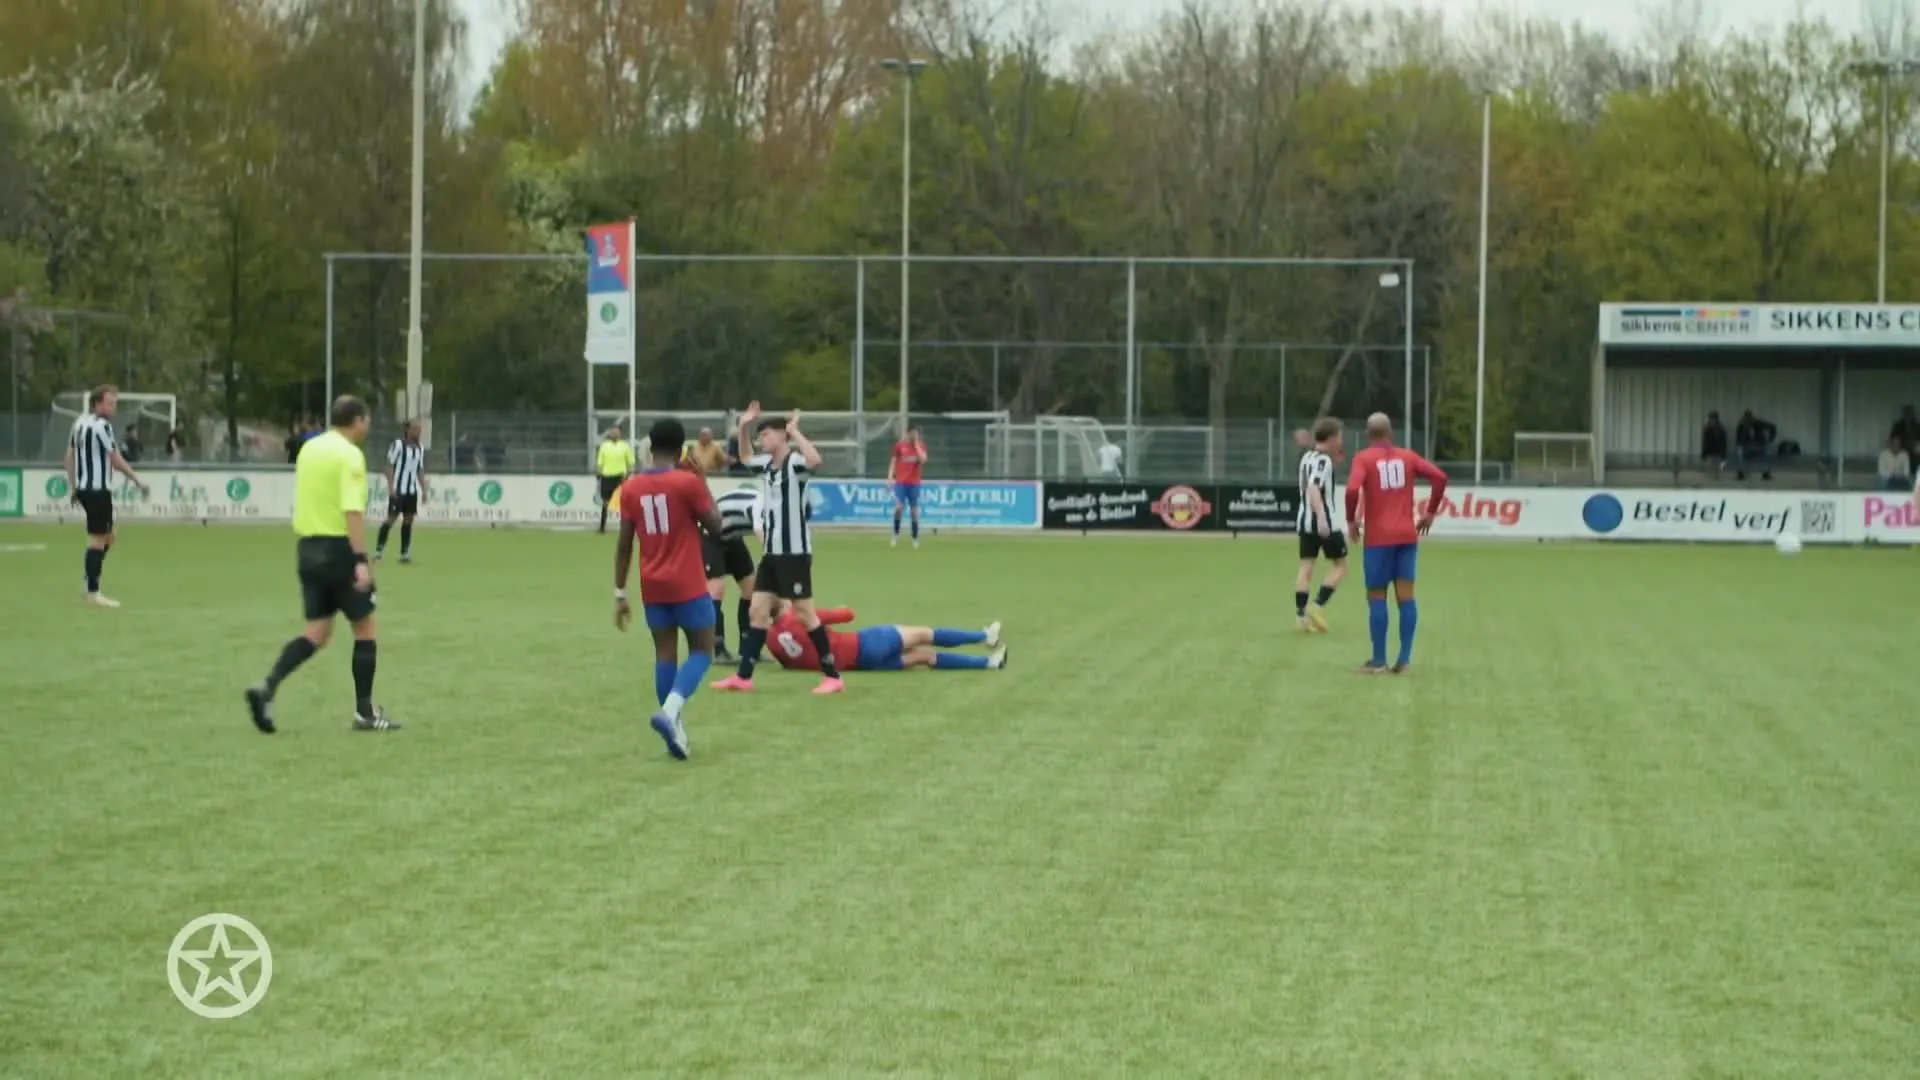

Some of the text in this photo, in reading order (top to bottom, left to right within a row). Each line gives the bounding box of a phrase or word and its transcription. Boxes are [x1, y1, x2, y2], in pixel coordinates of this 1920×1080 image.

[1770, 311, 1891, 330] SIKKENS
[1376, 459, 1406, 489] 10
[640, 494, 670, 536] 11
[1633, 499, 1791, 534] Bestel verf
